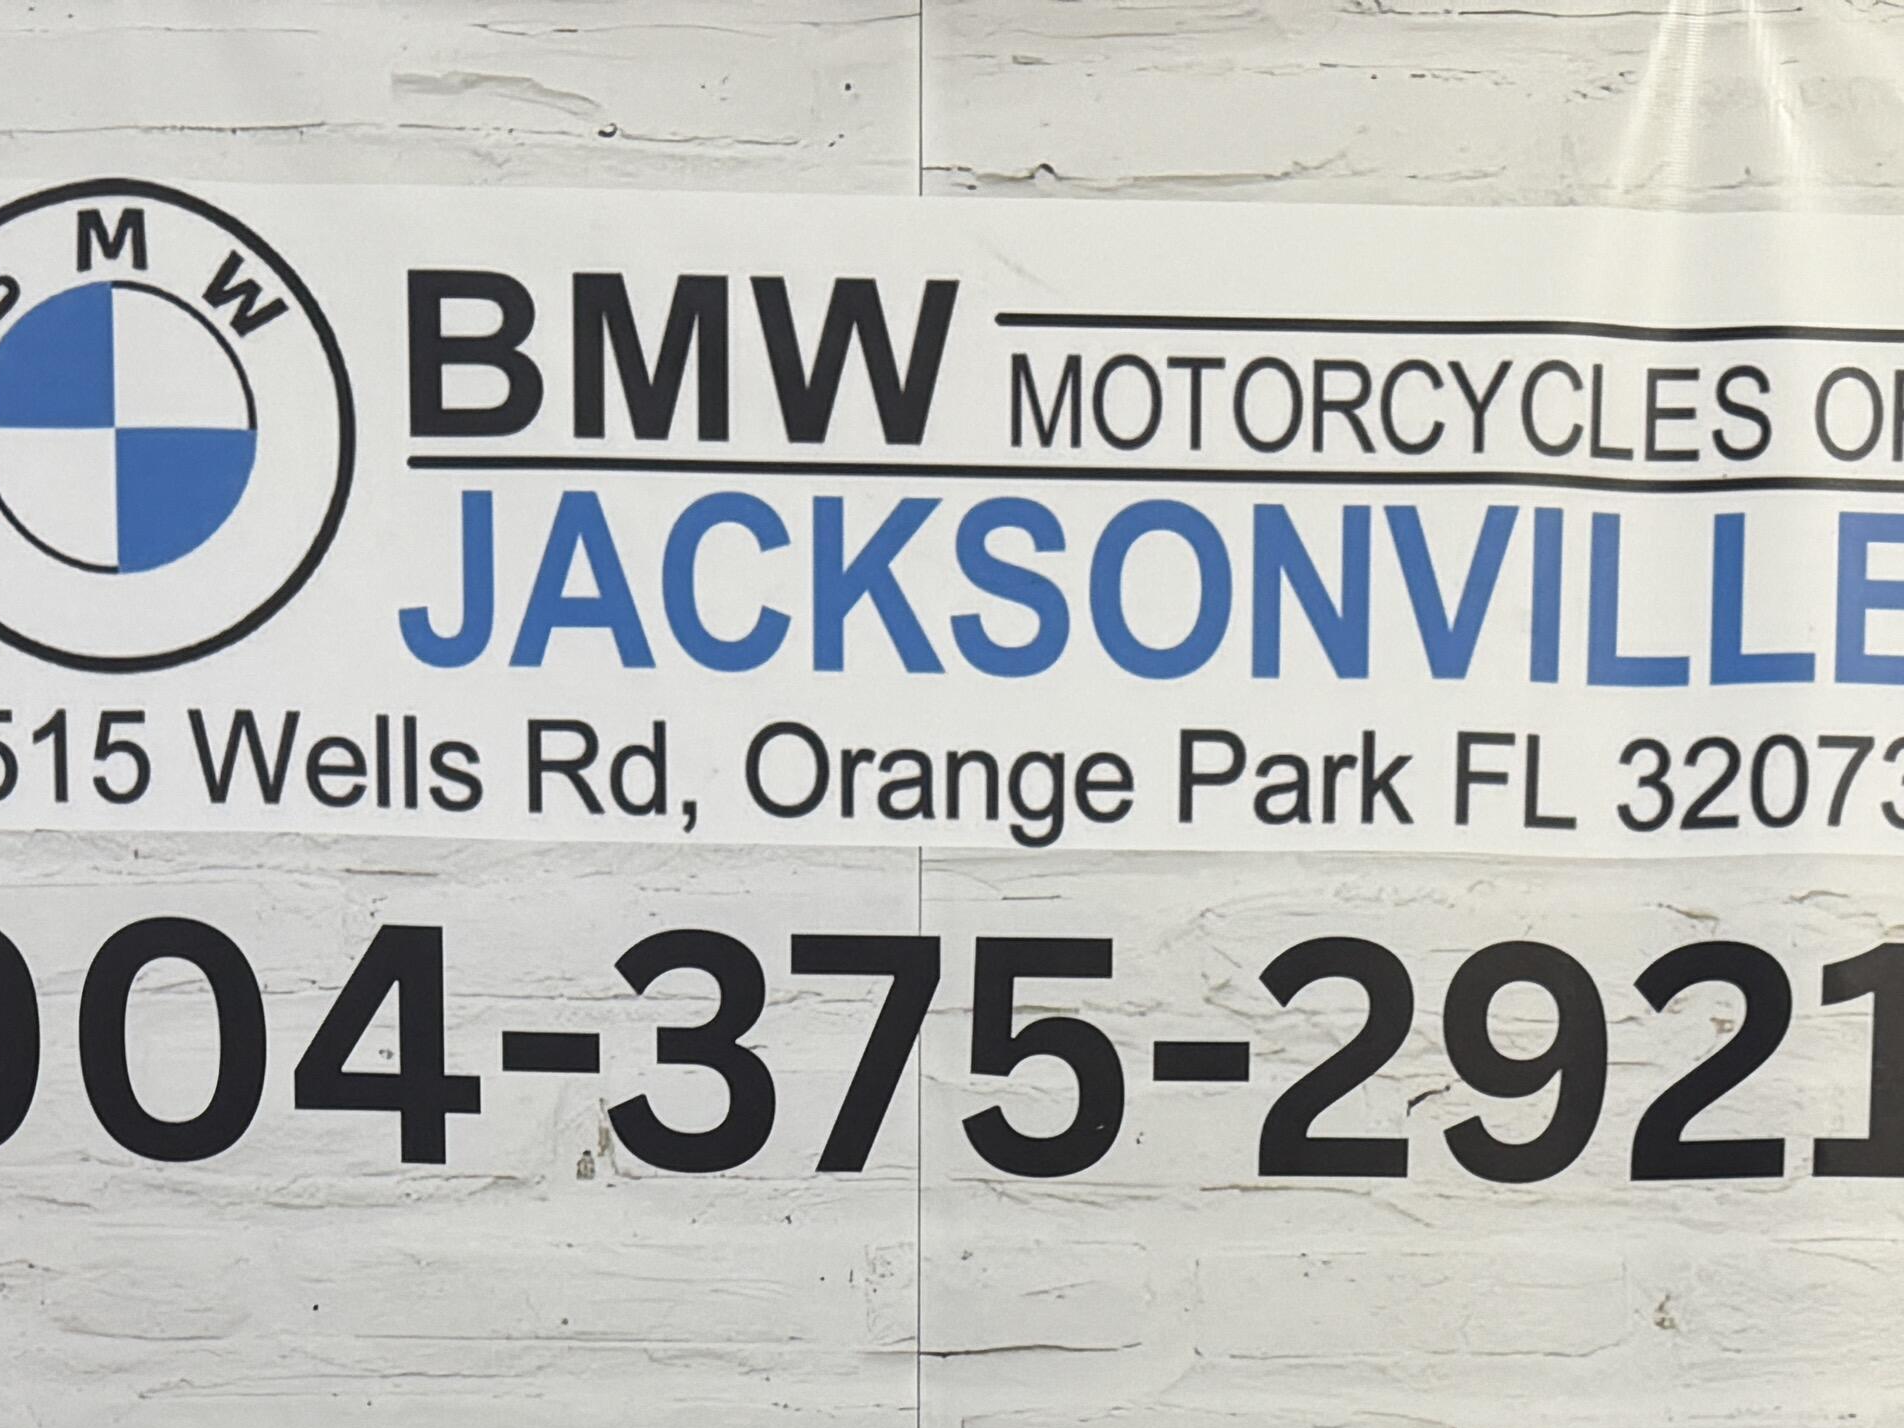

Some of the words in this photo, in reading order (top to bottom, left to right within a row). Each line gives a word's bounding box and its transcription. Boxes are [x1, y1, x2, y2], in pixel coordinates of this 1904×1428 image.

[407, 269, 960, 446] BMW
[1010, 353, 1773, 463] MOTORCYCLES
[187, 709, 484, 813] Wells
[527, 719, 698, 833] Rd,
[745, 721, 1135, 849] Orange
[1178, 728, 1415, 826] Park
[1454, 731, 1578, 831] FL
